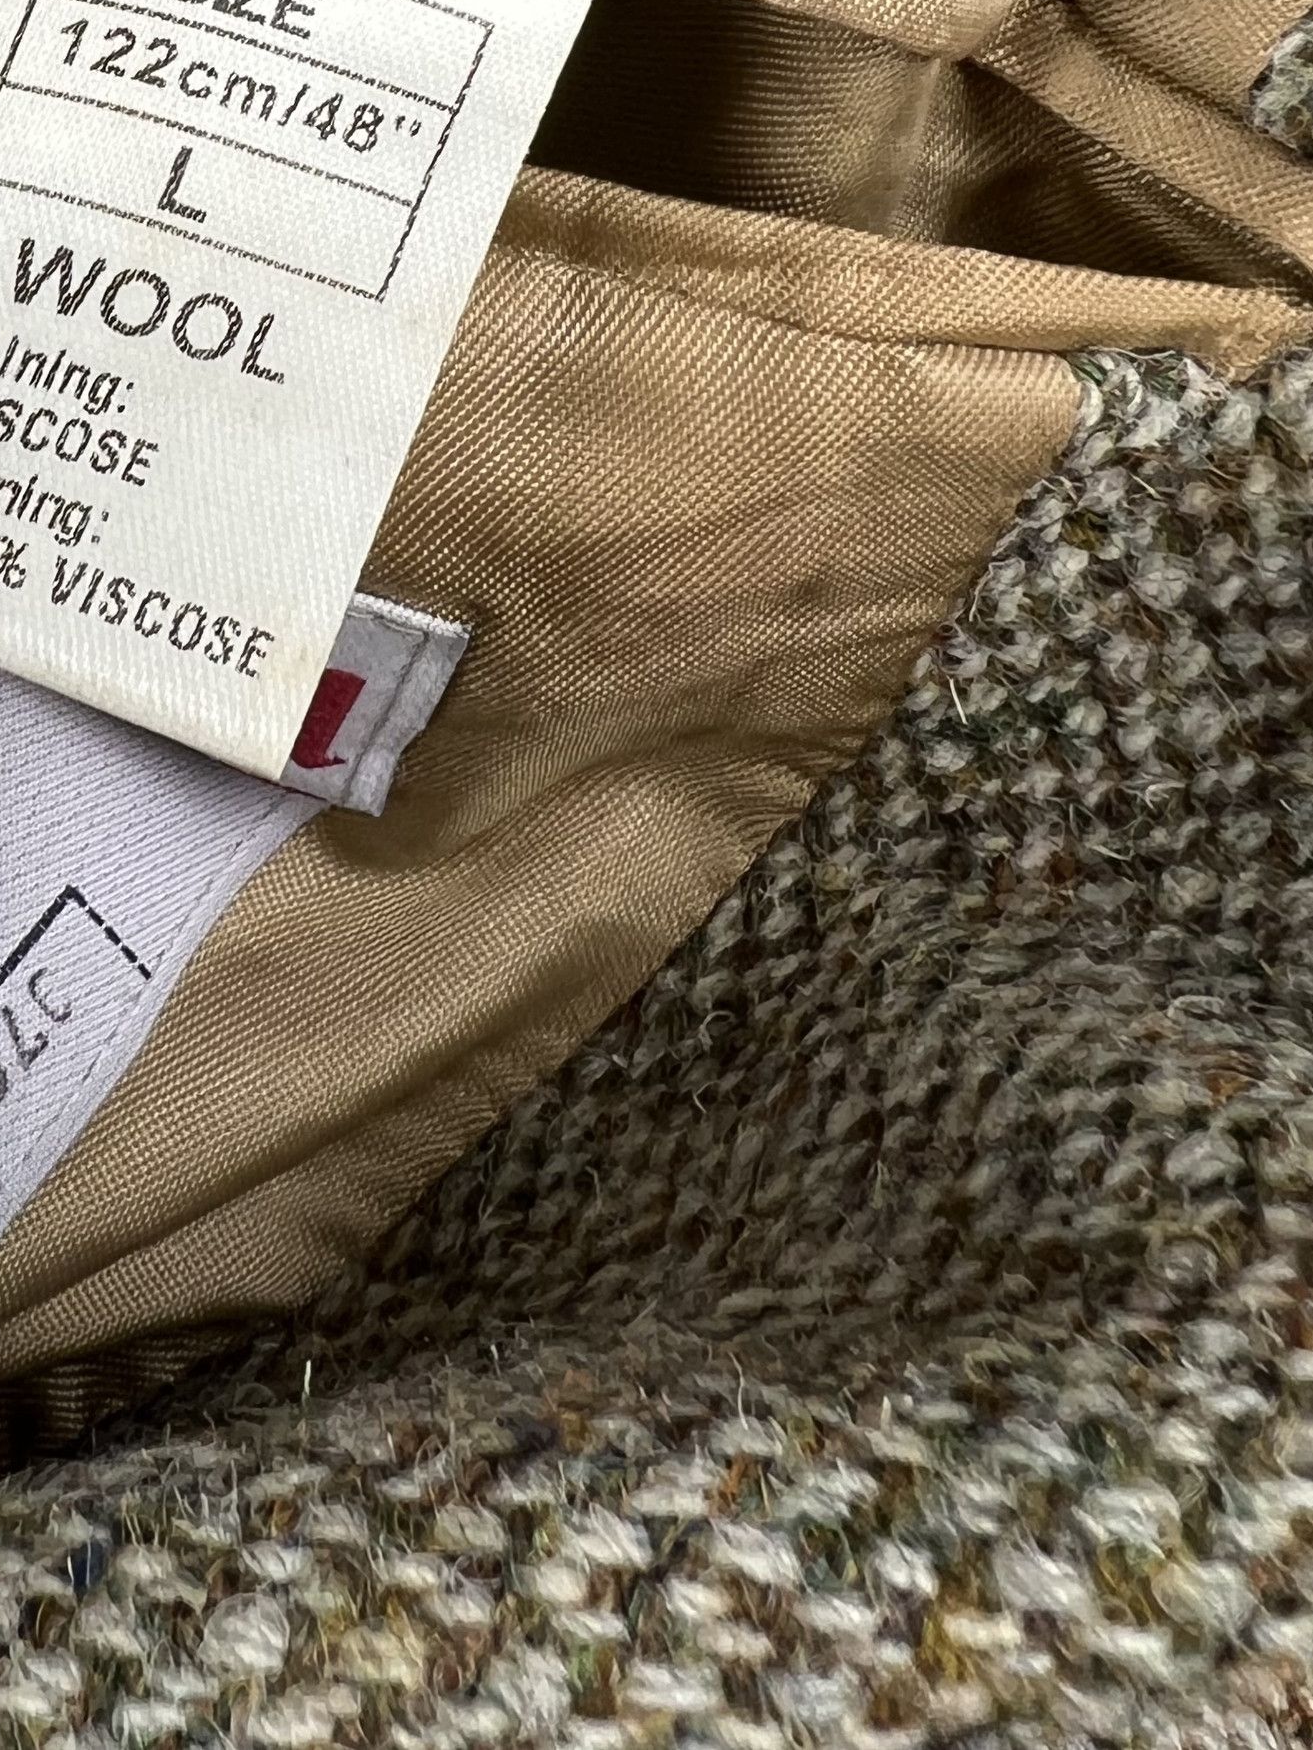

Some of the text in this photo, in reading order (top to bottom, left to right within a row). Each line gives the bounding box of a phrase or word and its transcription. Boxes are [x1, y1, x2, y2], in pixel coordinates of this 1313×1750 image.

[60, 18, 423, 154] 122cm/48"
[156, 145, 208, 224] L
[12, 237, 287, 385] WOOL
[50, 554, 275, 679] VISCOSE
